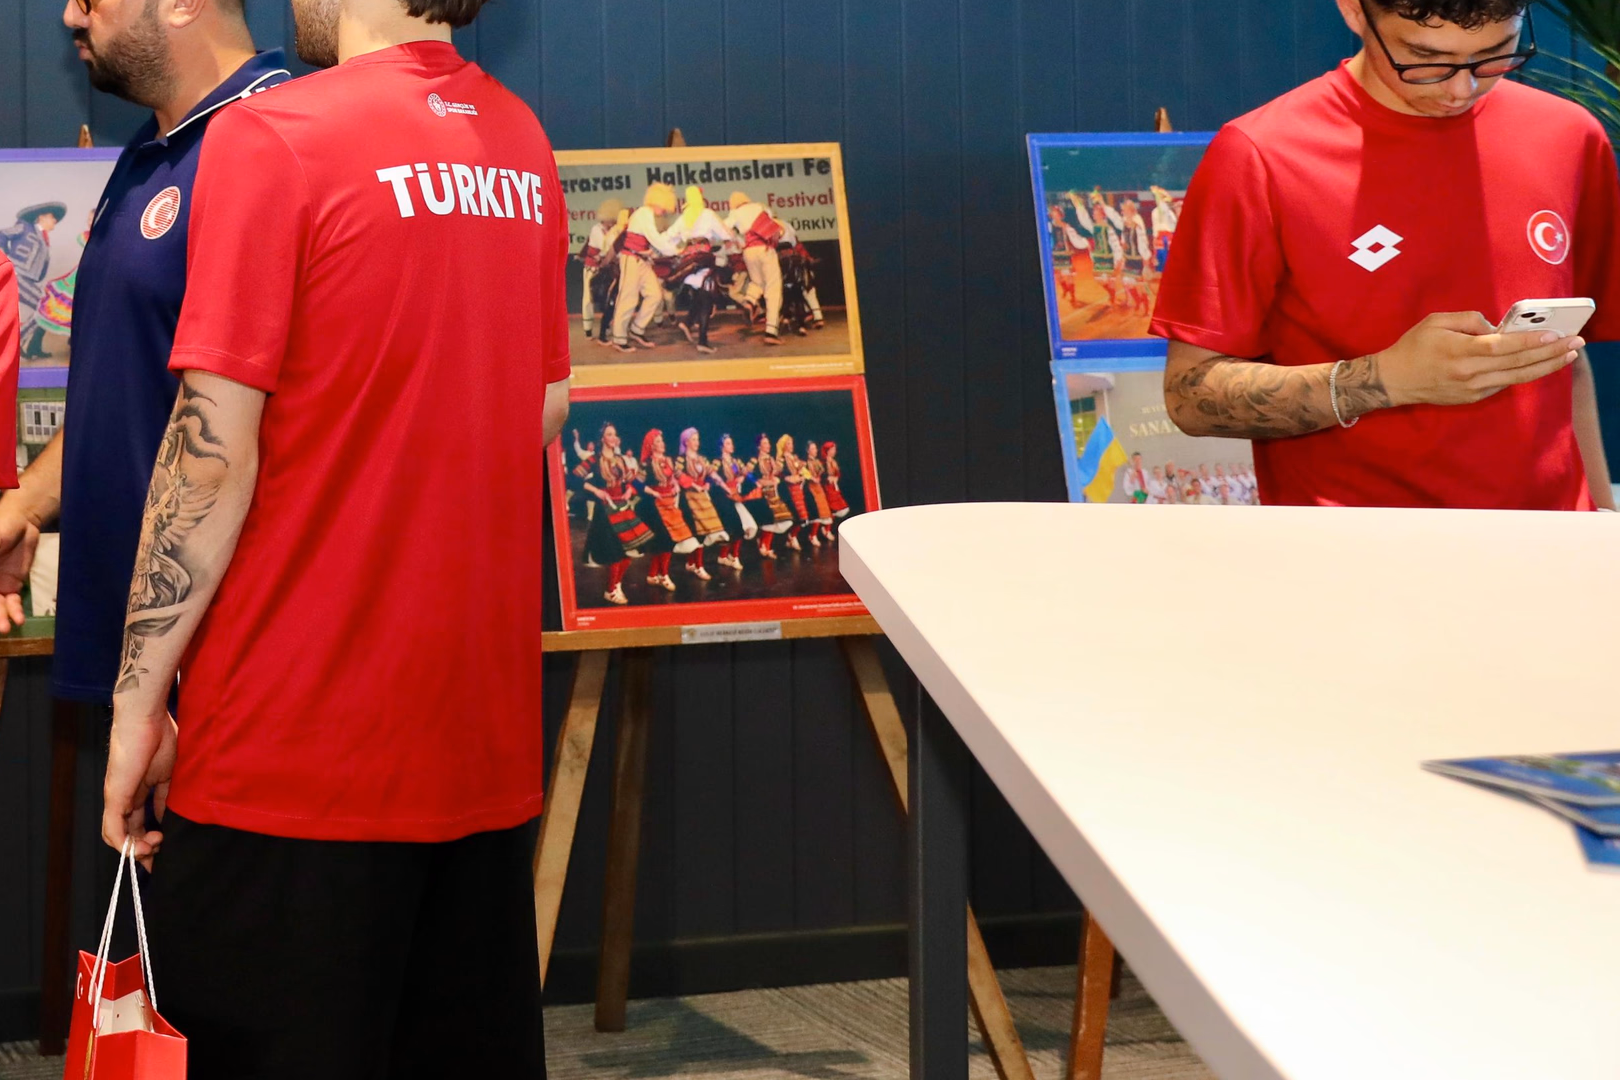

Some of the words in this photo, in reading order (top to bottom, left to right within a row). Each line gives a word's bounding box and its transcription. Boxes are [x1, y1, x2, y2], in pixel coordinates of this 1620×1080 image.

[647, 159, 793, 186] Halkdansları
[375, 162, 543, 225] TÜRKİYE
[767, 188, 834, 208] Festival
[791, 216, 835, 231] ÜRKİY
[1129, 419, 1178, 439] SANA
